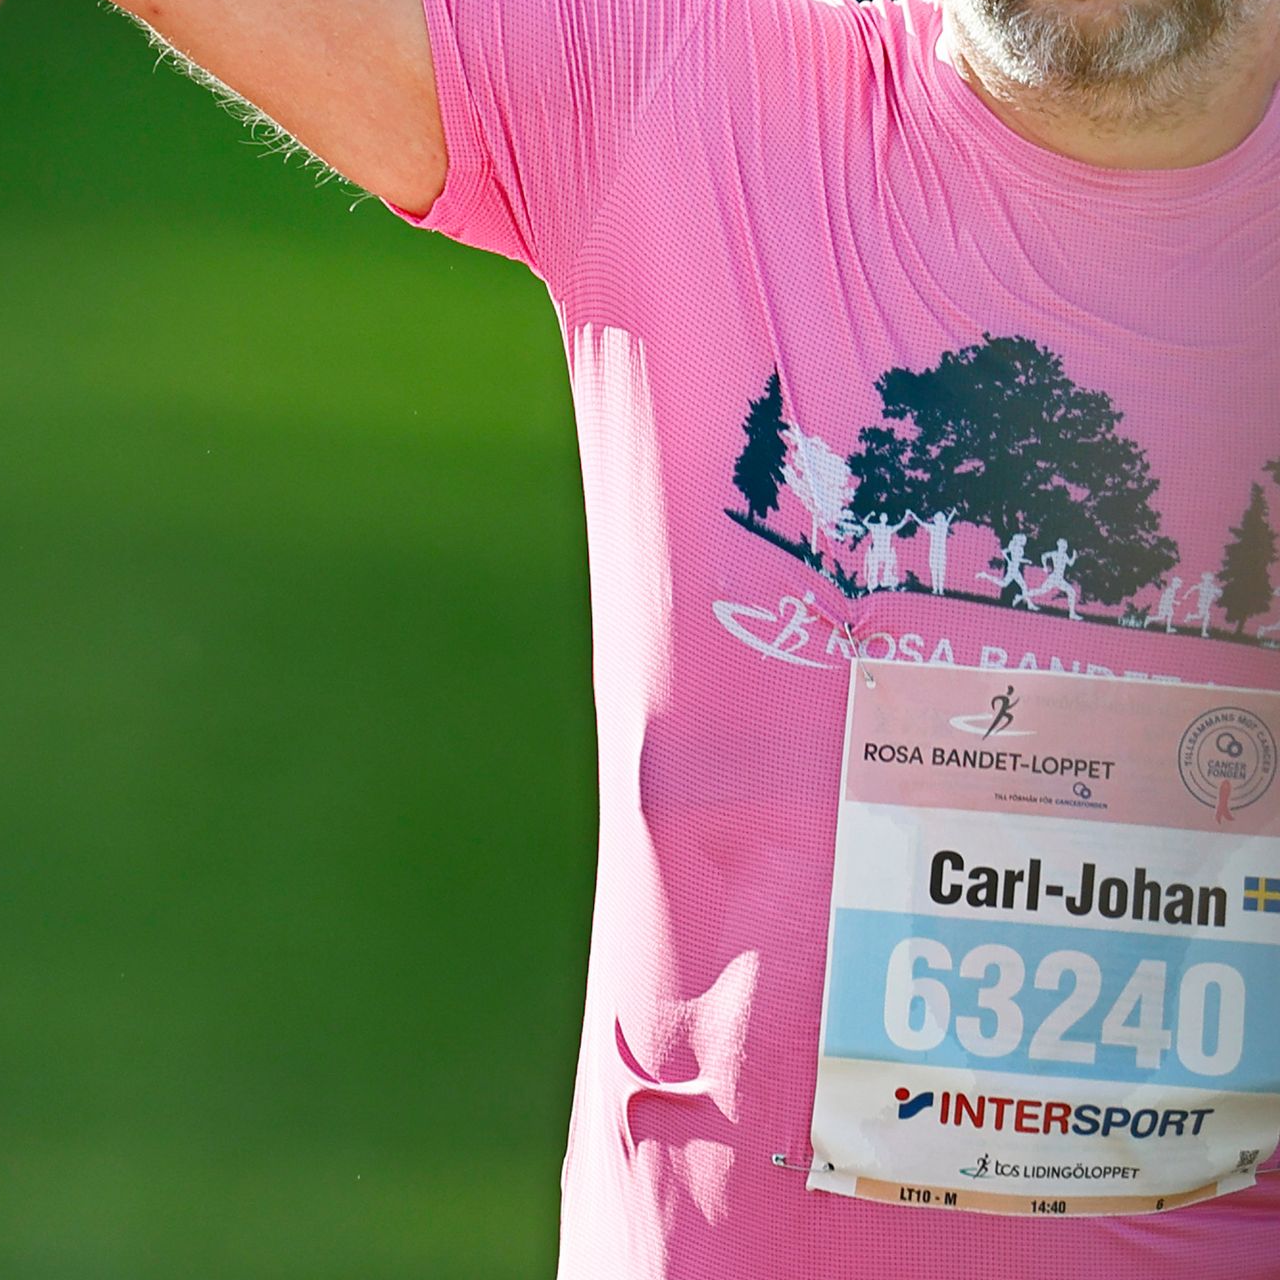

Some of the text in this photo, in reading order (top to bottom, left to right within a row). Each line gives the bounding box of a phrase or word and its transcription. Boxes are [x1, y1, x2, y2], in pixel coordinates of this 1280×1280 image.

[863, 742, 1115, 780] ROSA BANDET-LOPPET
[928, 850, 1227, 927] Carl-Johan
[882, 936, 1246, 1077] 63240
[939, 1091, 1214, 1139] INTERSPORT
[1024, 1165, 1140, 1180] LIDINGÖLOPPET
[899, 1186, 931, 1204] LT10
[944, 1191, 957, 1206] M
[1030, 1200, 1066, 1214] 14:40
